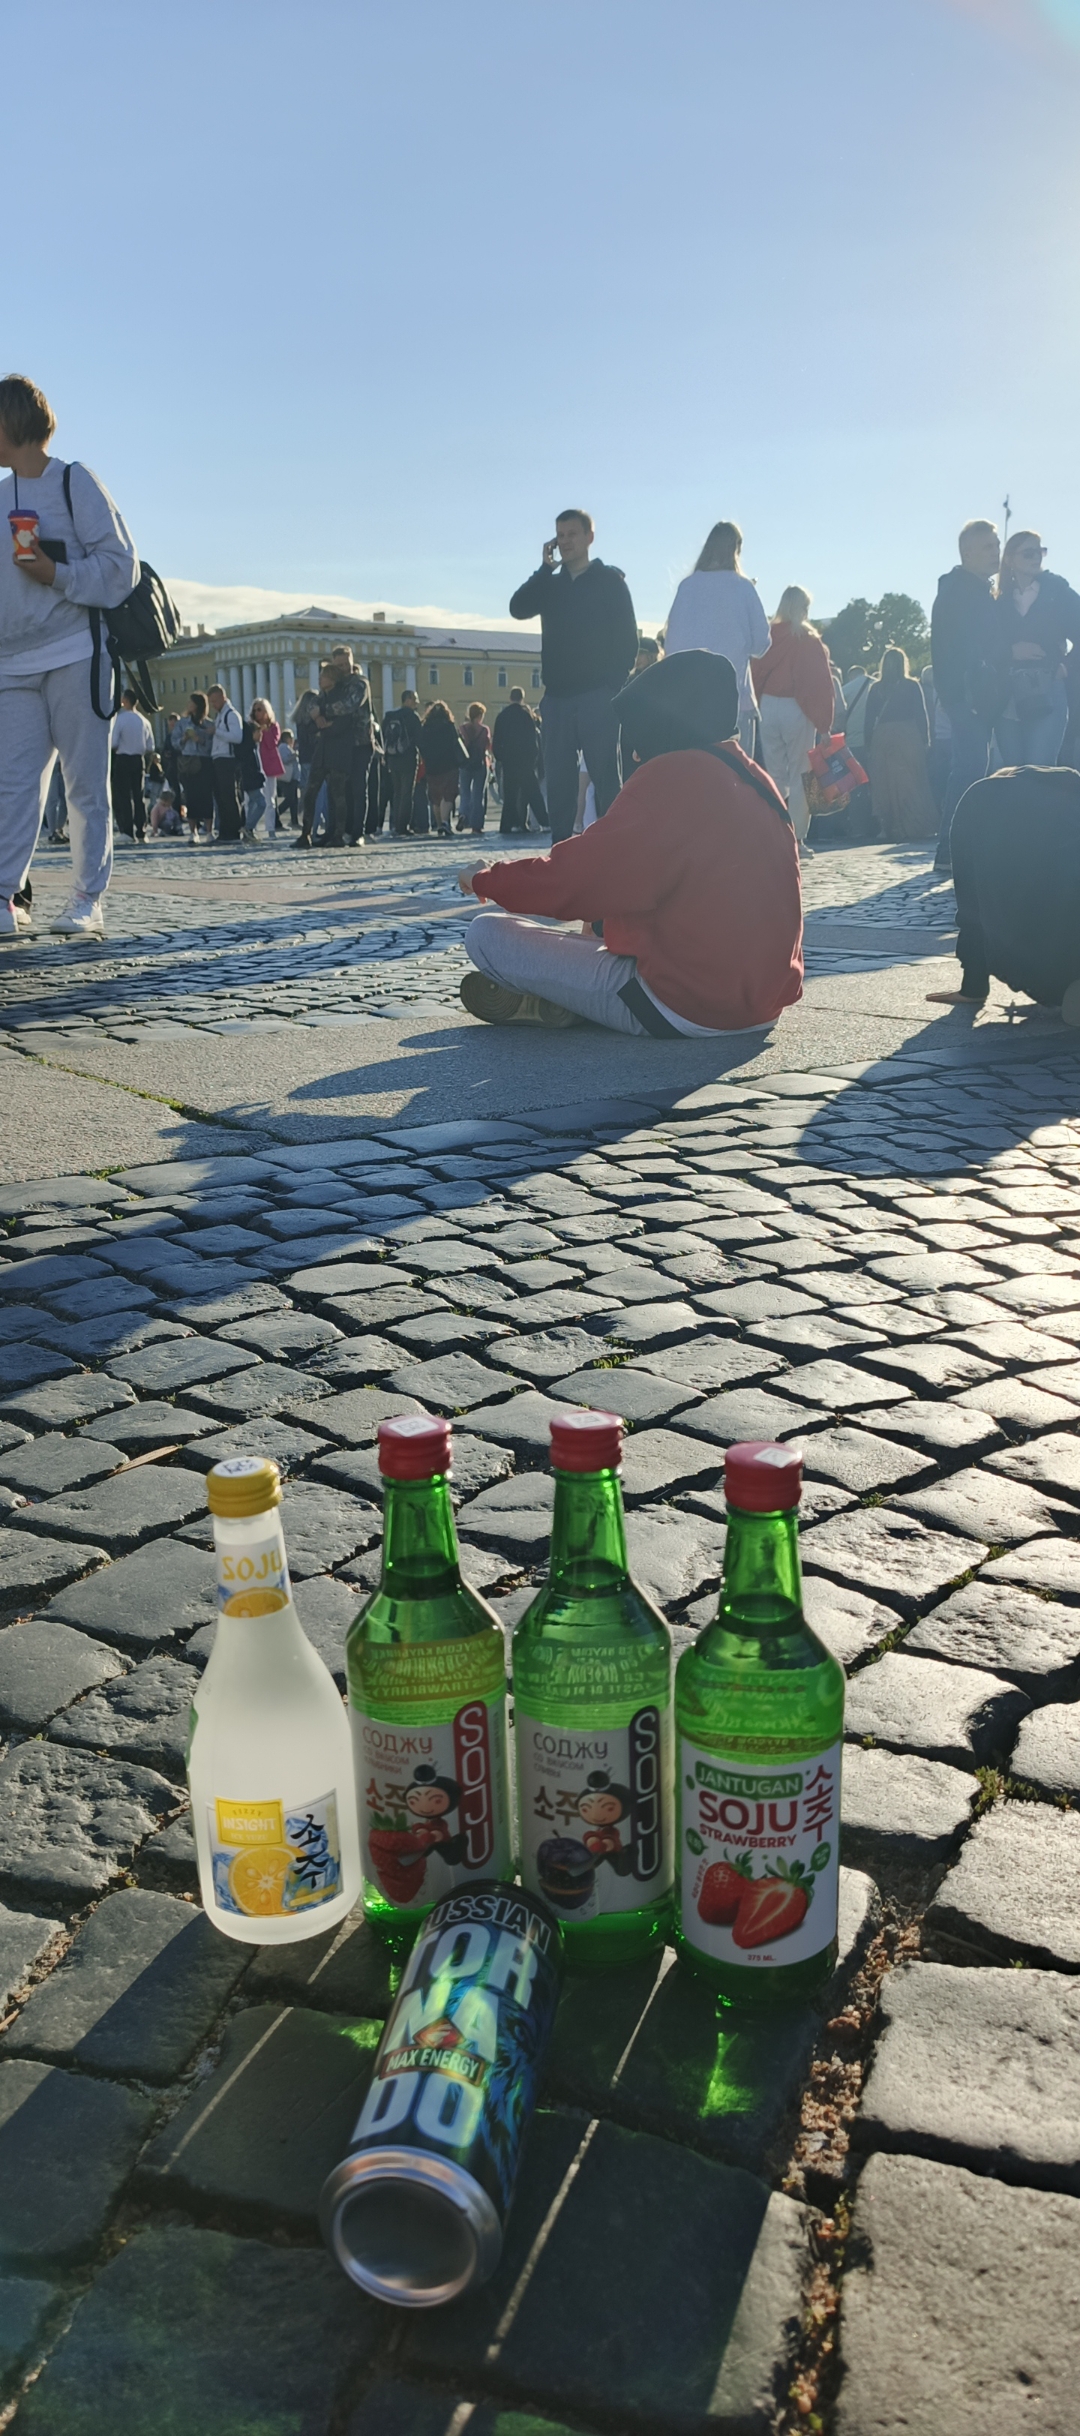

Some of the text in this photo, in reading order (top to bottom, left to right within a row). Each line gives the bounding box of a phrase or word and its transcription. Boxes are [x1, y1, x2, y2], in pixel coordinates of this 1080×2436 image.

[221, 1548, 283, 1582] SOJU
[362, 1726, 433, 1755] СОДЖУ
[533, 1732, 608, 1760] СОДЖУ
[459, 1706, 490, 1863] SOJU
[635, 1711, 660, 1875] SOJU
[698, 1766, 800, 1795] JANTUGAN
[533, 1785, 581, 1826] 소주
[698, 1790, 799, 1836] SOJU
[803, 1765, 834, 1843] 소주
[222, 1817, 277, 1832] INSIGHT
[699, 1823, 797, 1849] STRAWBERRY
[290, 1813, 329, 1889] 소주
[386, 2048, 480, 2079] MAX ENERGY
[350, 2070, 484, 2148] DO
